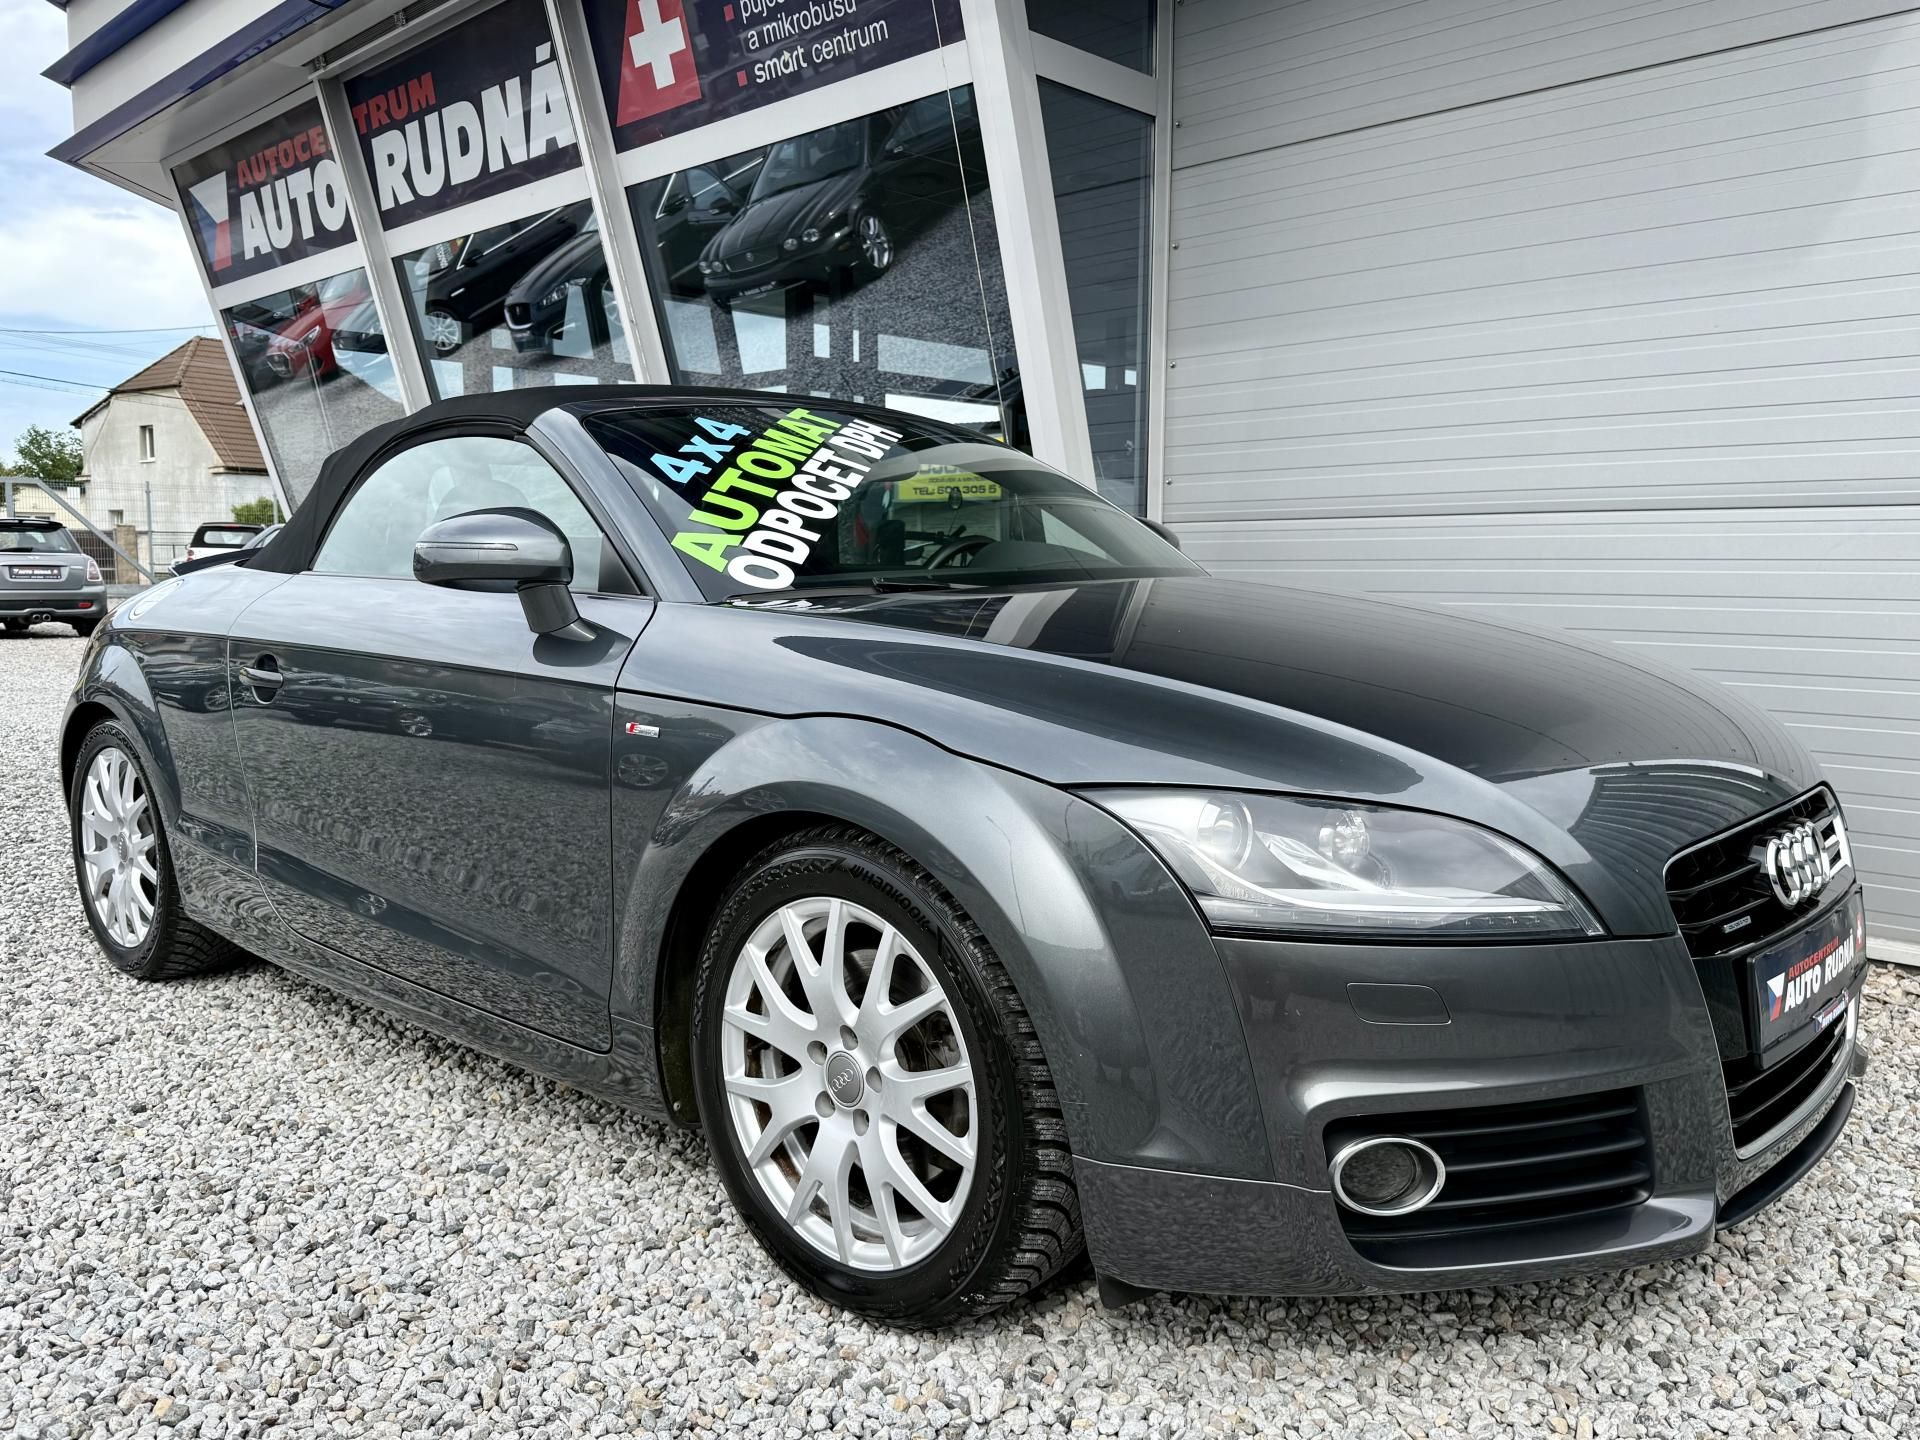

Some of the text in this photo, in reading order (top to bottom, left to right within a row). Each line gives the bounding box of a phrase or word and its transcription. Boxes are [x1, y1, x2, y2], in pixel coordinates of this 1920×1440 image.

[747, 30, 760, 49] a
[754, 19, 889, 83] smart centrum
[239, 41, 578, 260] AUTO RUDNÁ
[671, 408, 842, 573] AUTOMAT
[728, 447, 871, 590] ODPOCET
[828, 418, 903, 460] DPH
[1784, 964, 1821, 1013] AUTO
